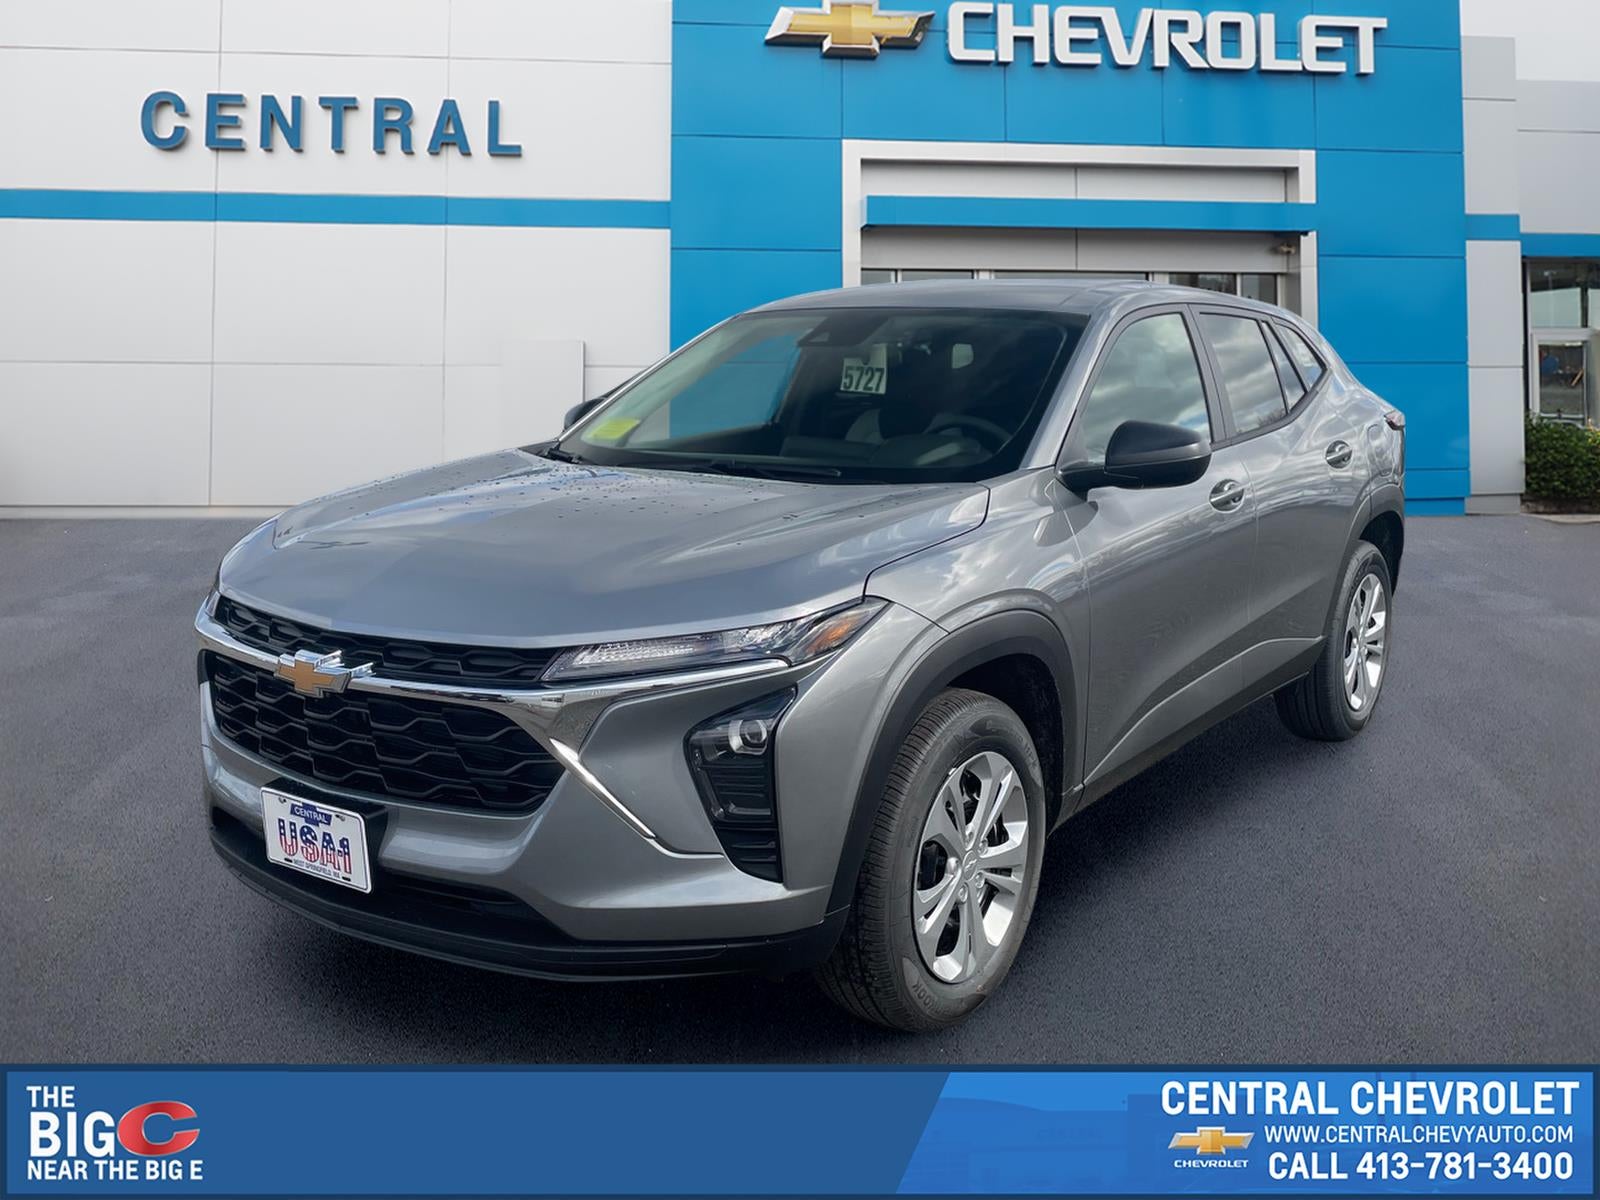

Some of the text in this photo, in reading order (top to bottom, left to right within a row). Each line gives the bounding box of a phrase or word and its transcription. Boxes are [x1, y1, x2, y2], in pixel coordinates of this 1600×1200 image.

[946, 1, 1388, 74] CHEVROLET
[140, 90, 523, 158] CENTRAL
[843, 366, 885, 392] 5727
[293, 806, 329, 824] CENTRAL
